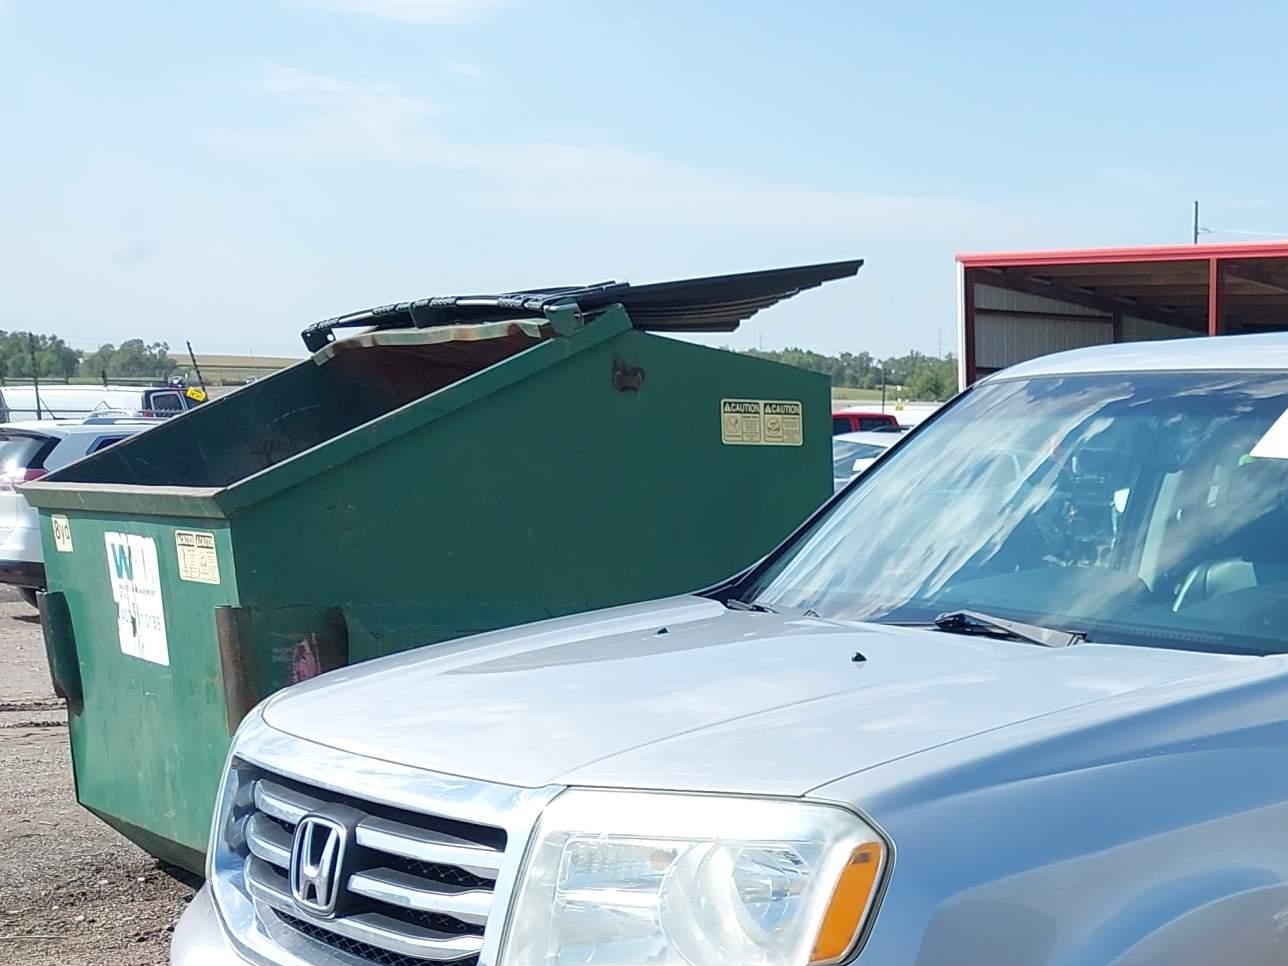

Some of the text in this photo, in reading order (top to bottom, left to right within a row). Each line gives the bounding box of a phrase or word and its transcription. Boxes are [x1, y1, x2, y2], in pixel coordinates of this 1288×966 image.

[731, 403, 760, 413] CAUTION
[772, 405, 800, 415] CAUTION
[54, 520, 71, 545] 8yd
